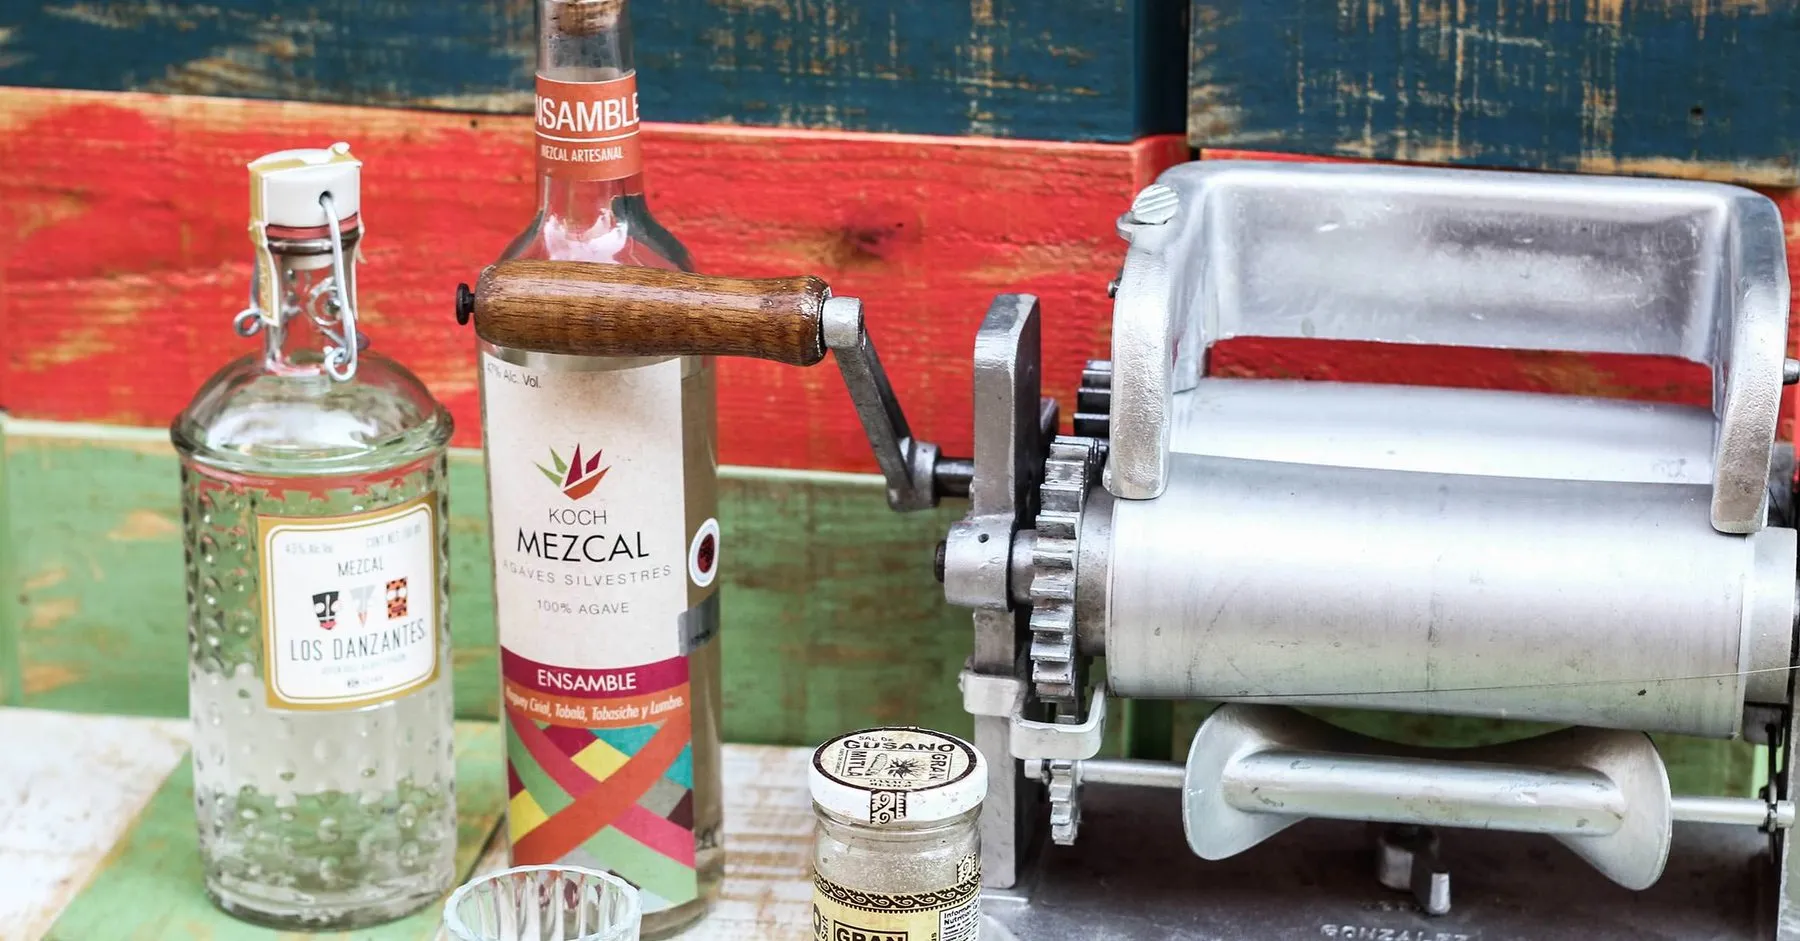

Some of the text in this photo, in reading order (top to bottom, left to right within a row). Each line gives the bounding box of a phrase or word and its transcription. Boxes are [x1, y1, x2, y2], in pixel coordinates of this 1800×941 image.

[541, 144, 624, 162] MEZCAL ARTESANAL
[523, 372, 541, 389] Vol.
[548, 508, 607, 526] KOCH
[516, 527, 650, 562] MEZCAL
[337, 556, 384, 577] MEZCAL
[502, 560, 672, 587] AGAVES SILVESTRES
[537, 599, 630, 615] 100% AGAVE
[290, 618, 426, 662] LOS DANZANTES
[537, 668, 637, 692] ENSAMBLE
[641, 705, 649, 719] y
[843, 740, 956, 752] GUSANO
[848, 751, 868, 777] MITLA
[929, 753, 948, 780] GRAN
